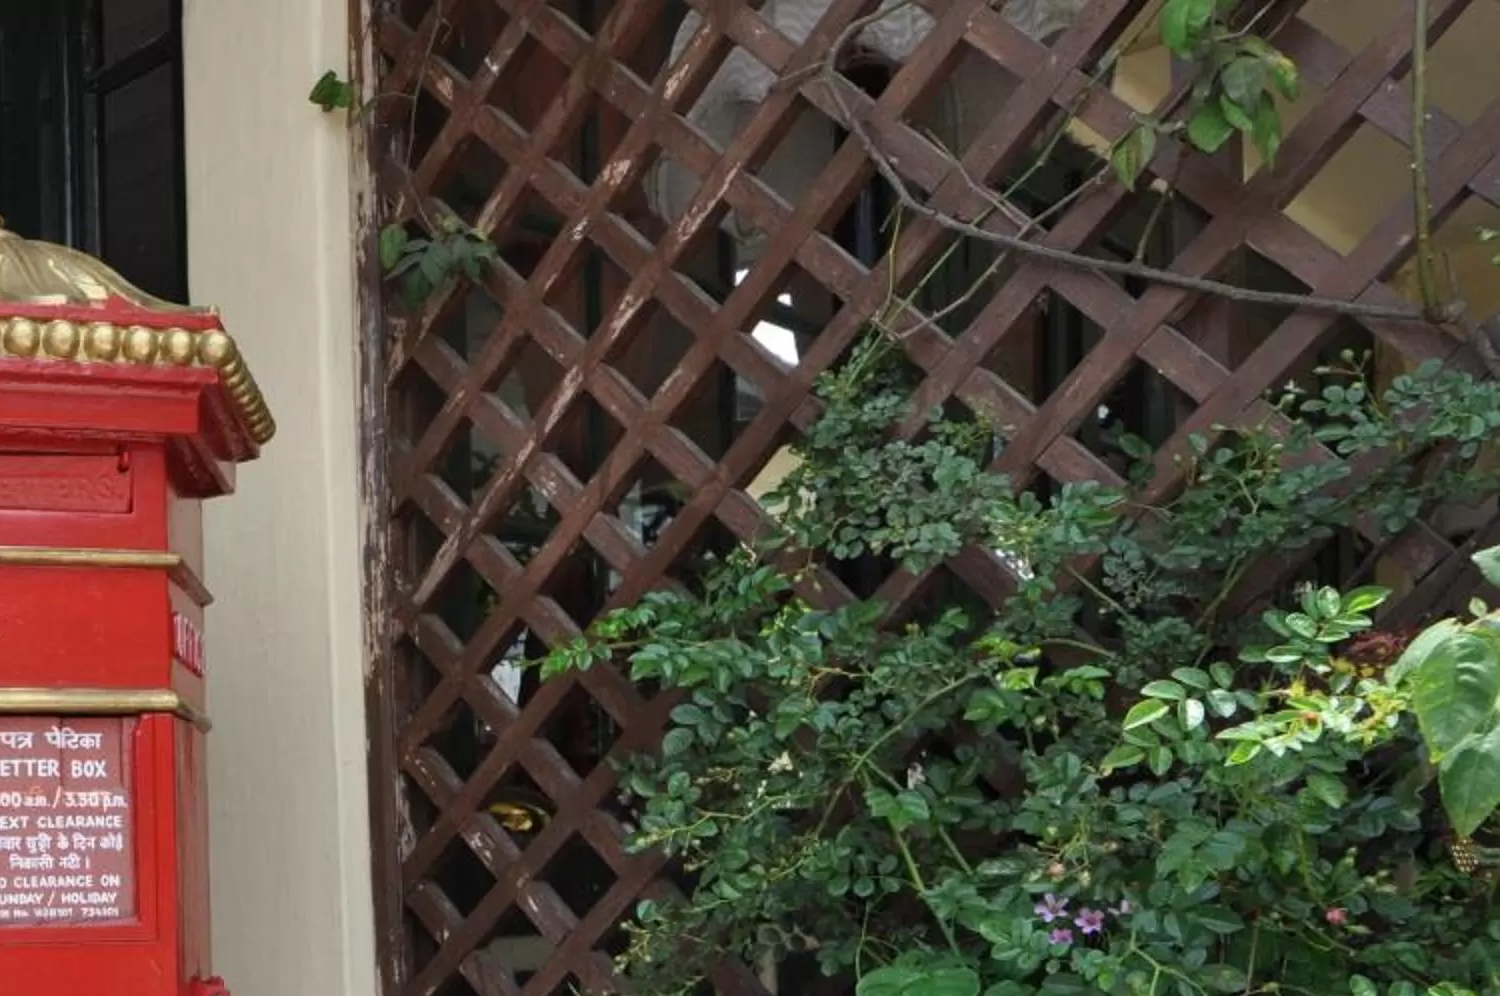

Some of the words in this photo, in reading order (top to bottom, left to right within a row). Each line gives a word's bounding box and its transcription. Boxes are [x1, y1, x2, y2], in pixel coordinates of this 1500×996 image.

[44, 725, 103, 750] पेटिका
[71, 760, 107, 778] BOX
[37, 815, 123, 829] CLEARANCE
[13, 875, 93, 889] CLEARANCE
[100, 874, 120, 887] ON
[61, 891, 117, 904] HOLIDAY
